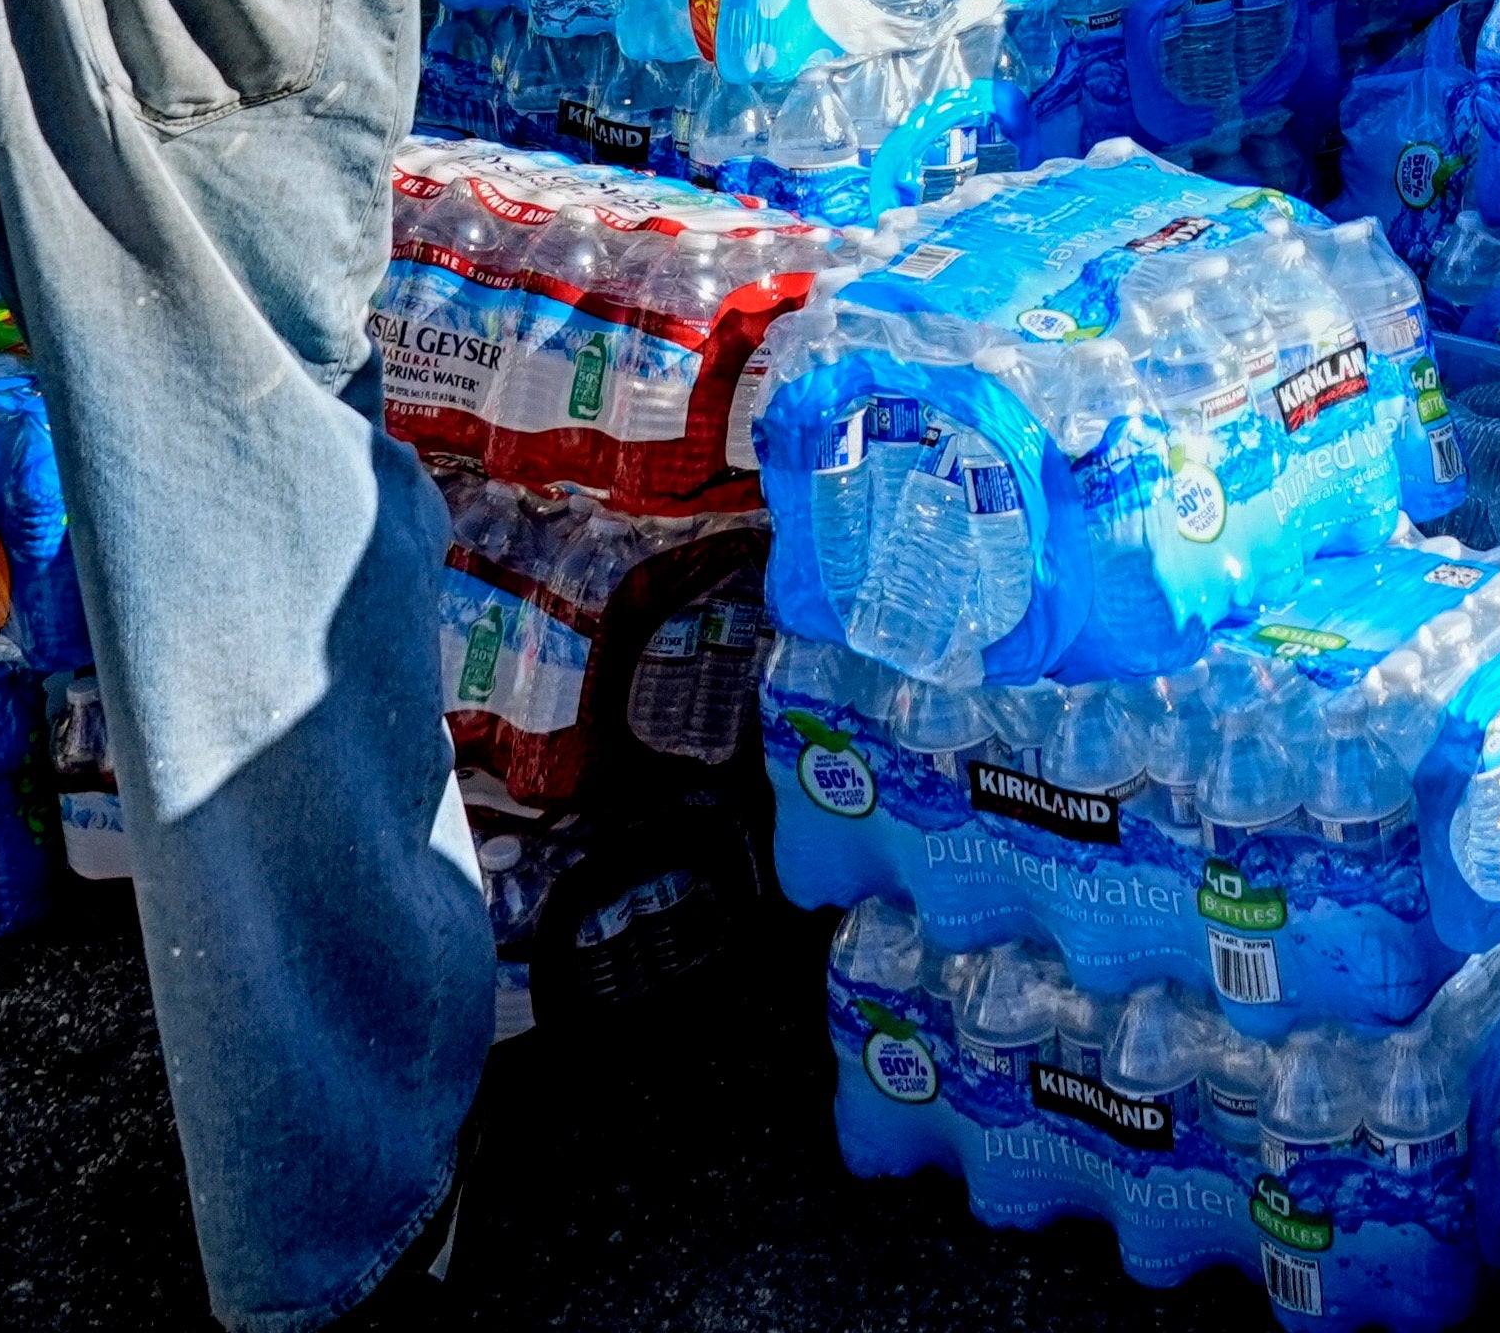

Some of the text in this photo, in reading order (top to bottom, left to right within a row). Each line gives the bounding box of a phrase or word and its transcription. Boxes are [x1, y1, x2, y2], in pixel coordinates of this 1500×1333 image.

[403, 179, 422, 193] BE
[433, 251, 459, 270] THE
[364, 316, 502, 370] YSTAL GEYSER
[384, 363, 476, 392] SPRING WATER
[1277, 345, 1367, 415] KIRKLAN
[392, 402, 439, 418] ROXANE
[815, 767, 866, 792] 50%
[978, 767, 1112, 827] KIRKLAND
[924, 831, 1184, 917] purified water
[1205, 865, 1242, 900] 40
[1203, 895, 1281, 926] BOTTLES
[1039, 1068, 1166, 1134] KIRKLAND
[983, 1128, 1237, 1220] purified water
[1256, 1184, 1291, 1219] 40
